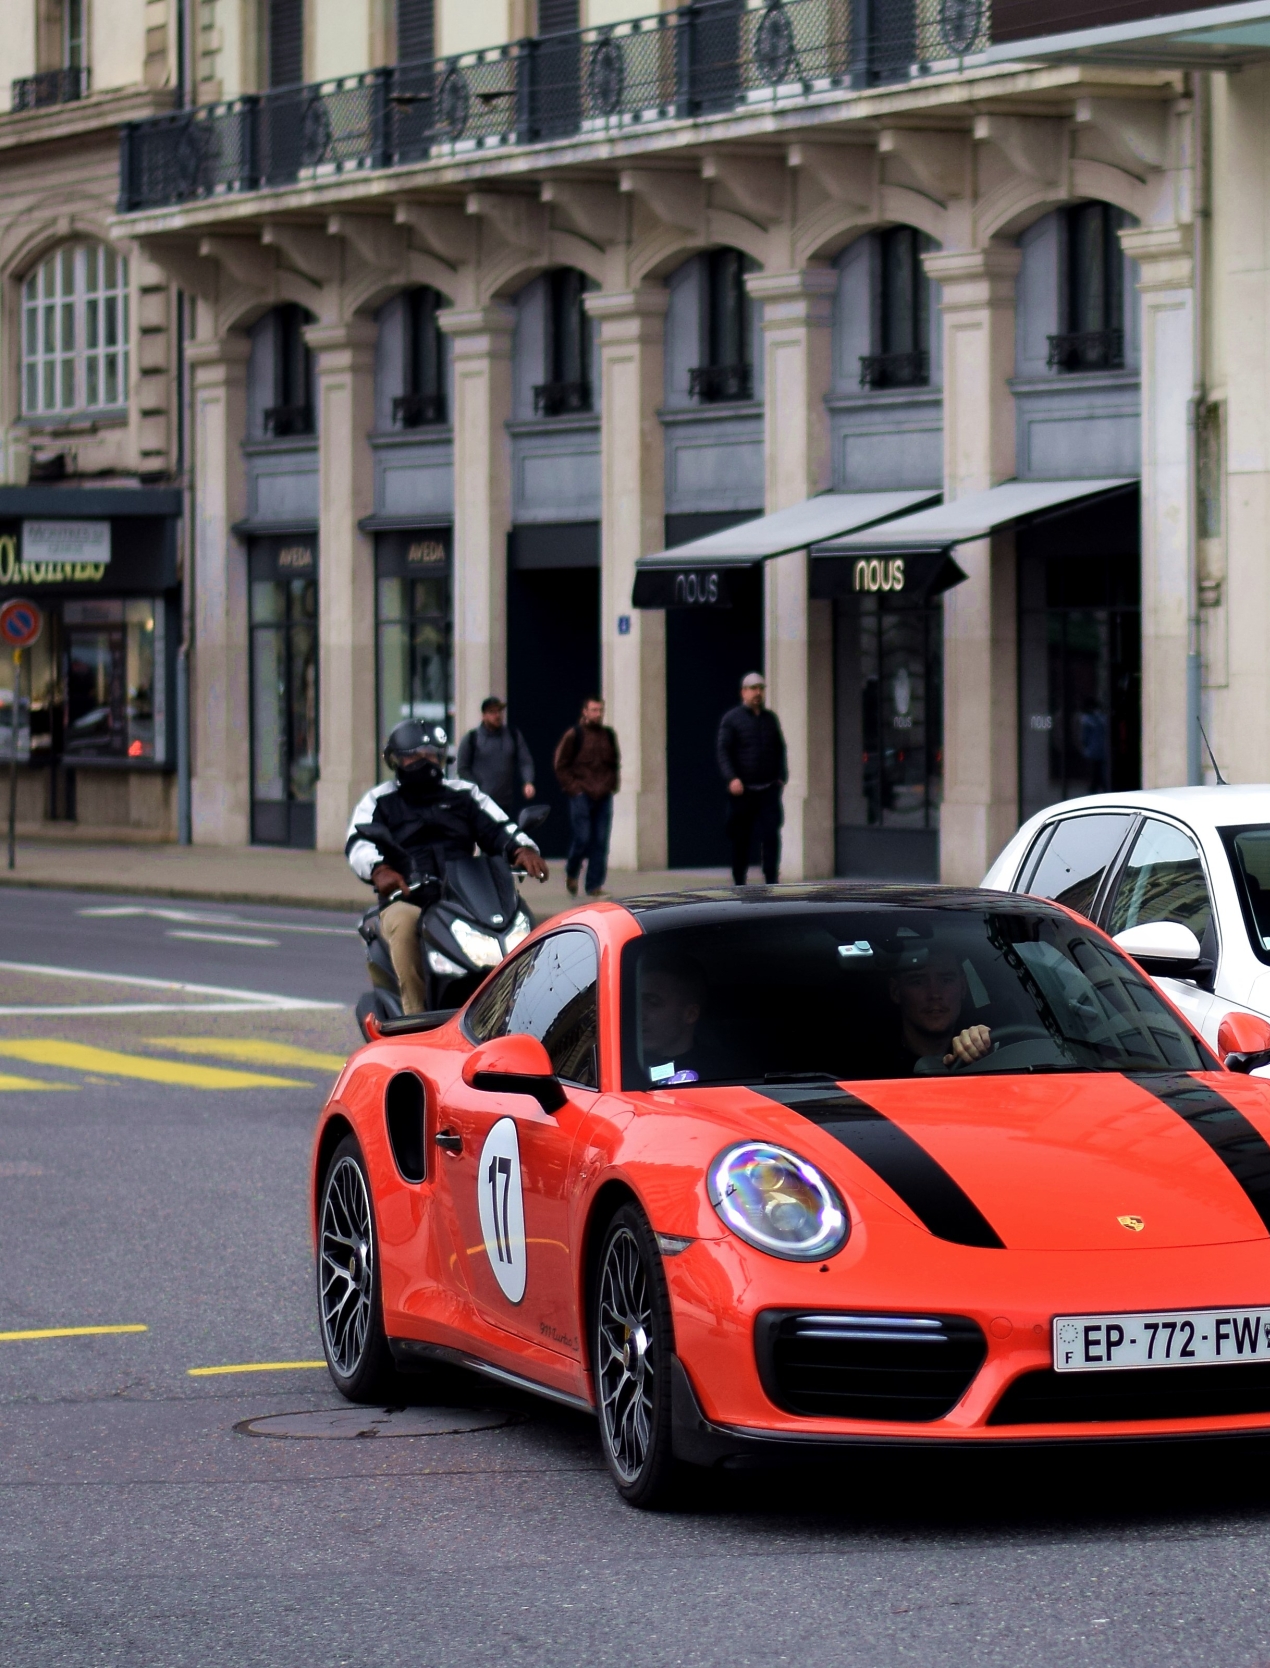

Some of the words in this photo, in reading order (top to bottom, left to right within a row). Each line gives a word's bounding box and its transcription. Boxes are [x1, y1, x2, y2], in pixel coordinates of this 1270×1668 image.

[278, 547, 313, 567] AVEDA
[407, 541, 445, 563] AVEDA
[488, 1155, 513, 1265] 17
[1065, 1351, 1074, 1365] F
